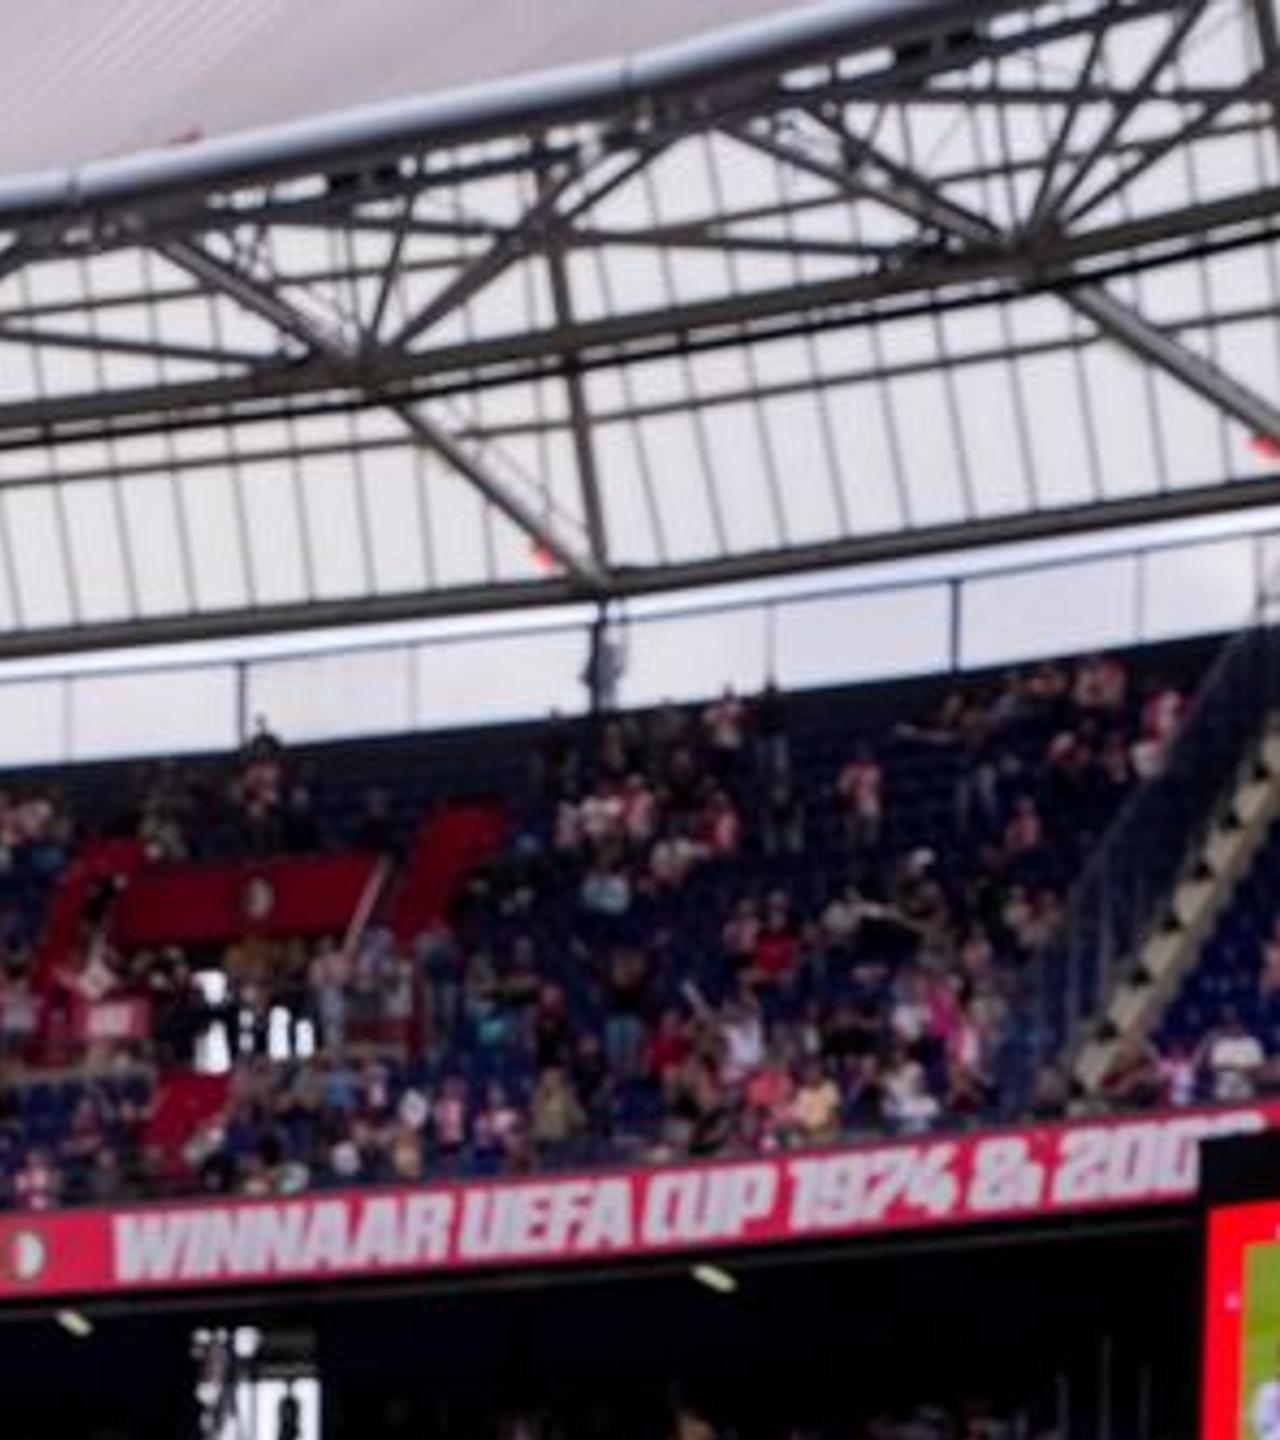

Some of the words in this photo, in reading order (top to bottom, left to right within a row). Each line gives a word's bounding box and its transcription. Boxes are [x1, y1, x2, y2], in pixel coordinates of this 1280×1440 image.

[112, 1194, 454, 1282] WINNAAR
[459, 1177, 632, 1257] UEFA
[642, 1162, 777, 1248] CUP
[787, 1143, 959, 1231] 1974
[966, 1136, 1043, 1212] &
[1052, 1109, 1266, 1202] 200
